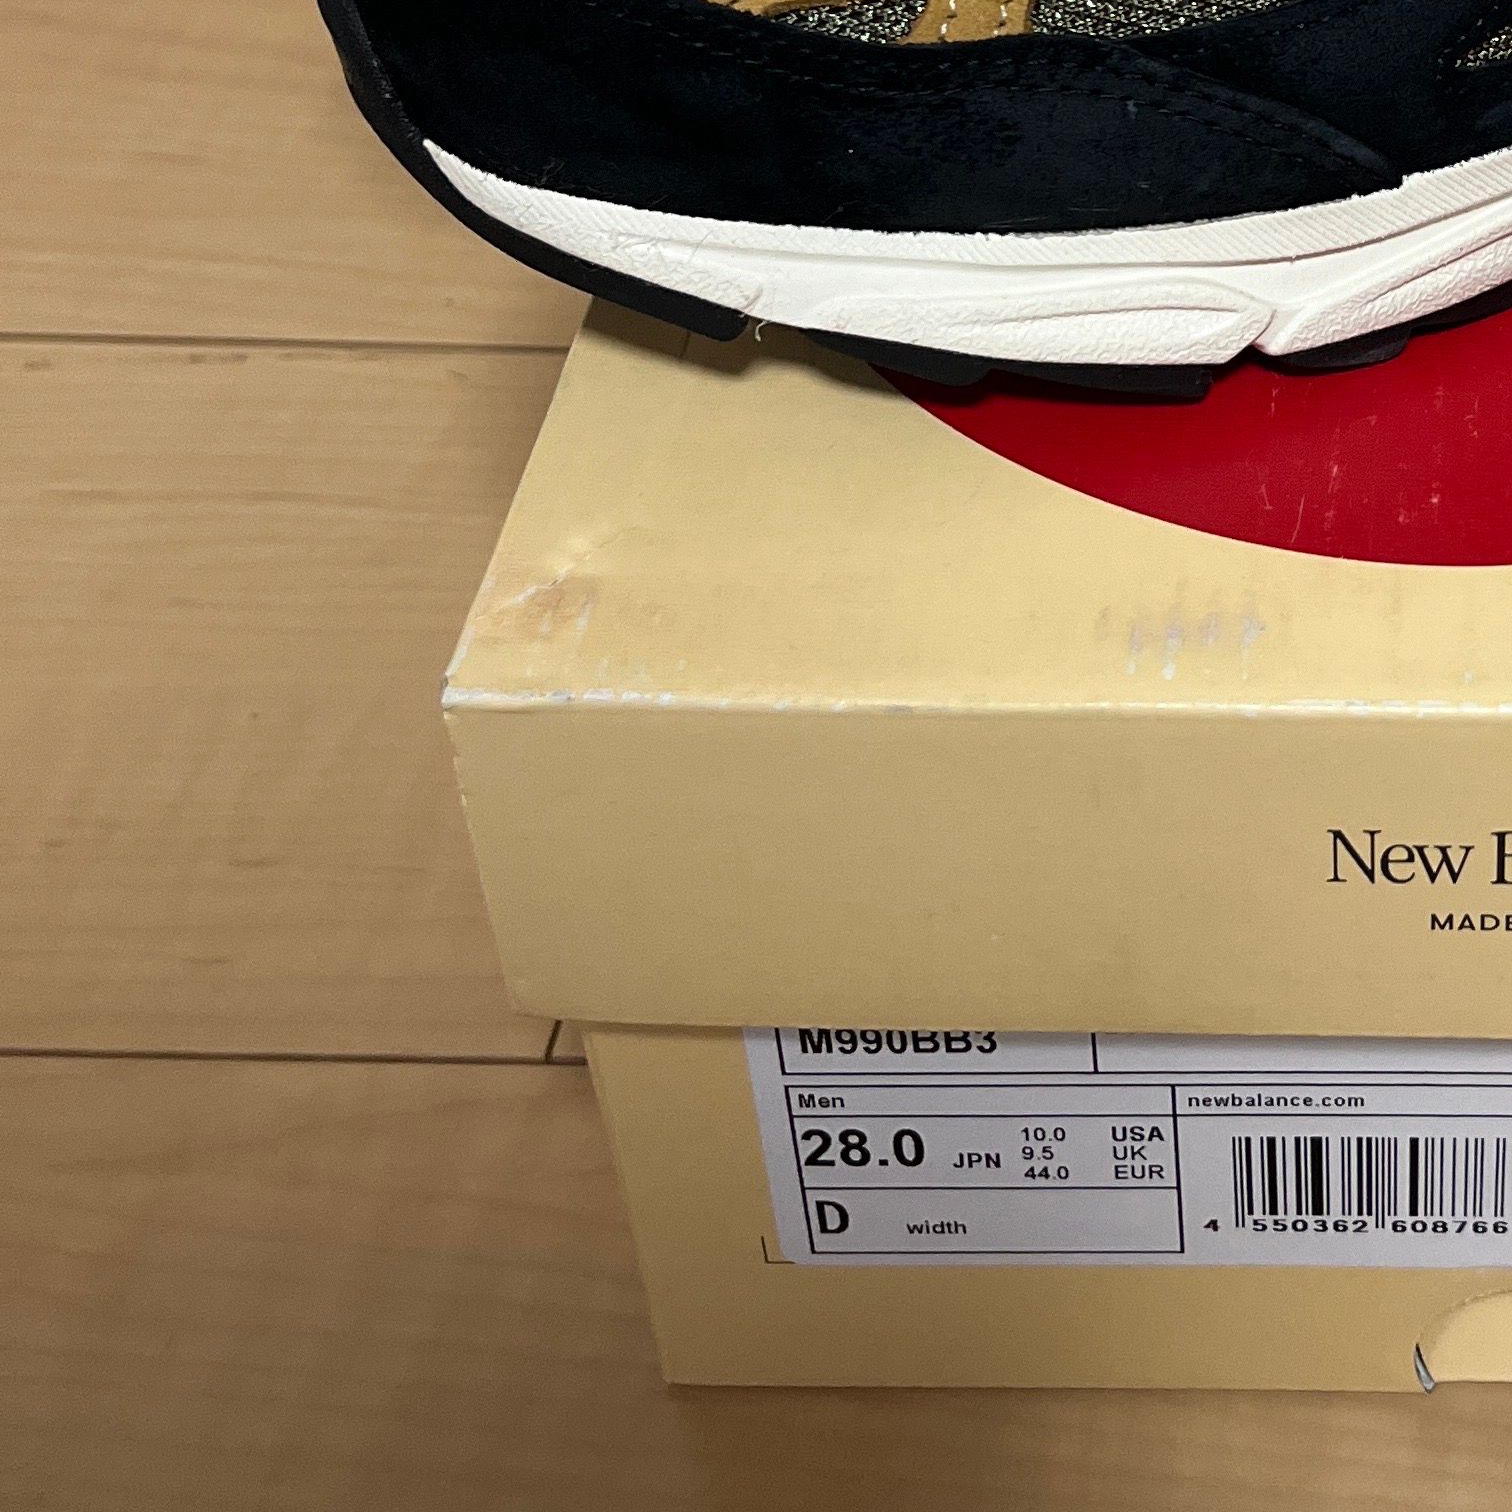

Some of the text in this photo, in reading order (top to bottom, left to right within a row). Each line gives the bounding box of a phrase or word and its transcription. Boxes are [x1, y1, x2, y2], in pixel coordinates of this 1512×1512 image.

[1326, 829, 1475, 885] New
[799, 1029, 998, 1055] M990BB3
[798, 1093, 846, 1109] Men
[1187, 1093, 1366, 1108] newbalance.com
[1020, 1126, 1165, 1143] 10.0 USA
[800, 1128, 1002, 1170] 28.0 JPN
[1021, 1145, 1148, 1162] 9.5 UK
[1023, 1165, 1166, 1181] 44.0 EUR
[815, 1200, 968, 1235] D width
[1203, 1219, 1509, 1234] 4 550362 608766
